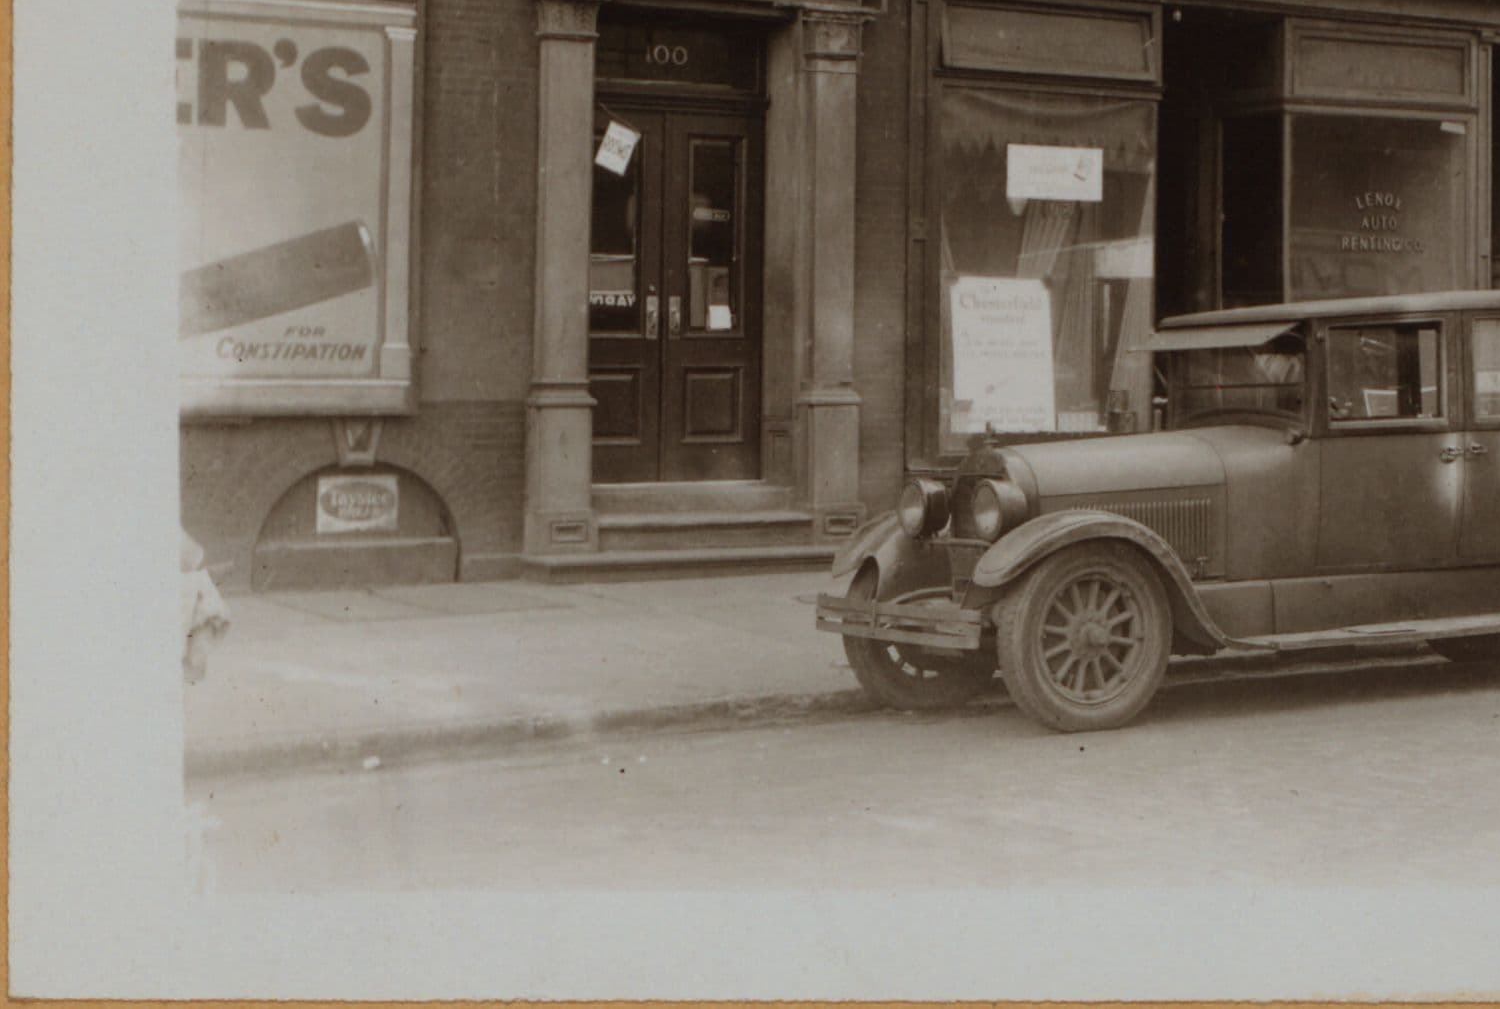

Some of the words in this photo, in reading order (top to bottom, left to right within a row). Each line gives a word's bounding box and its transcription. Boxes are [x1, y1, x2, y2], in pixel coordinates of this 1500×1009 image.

[646, 44, 689, 65] 100
[1361, 214, 1398, 230] AUTO
[284, 326, 327, 337] FOR
